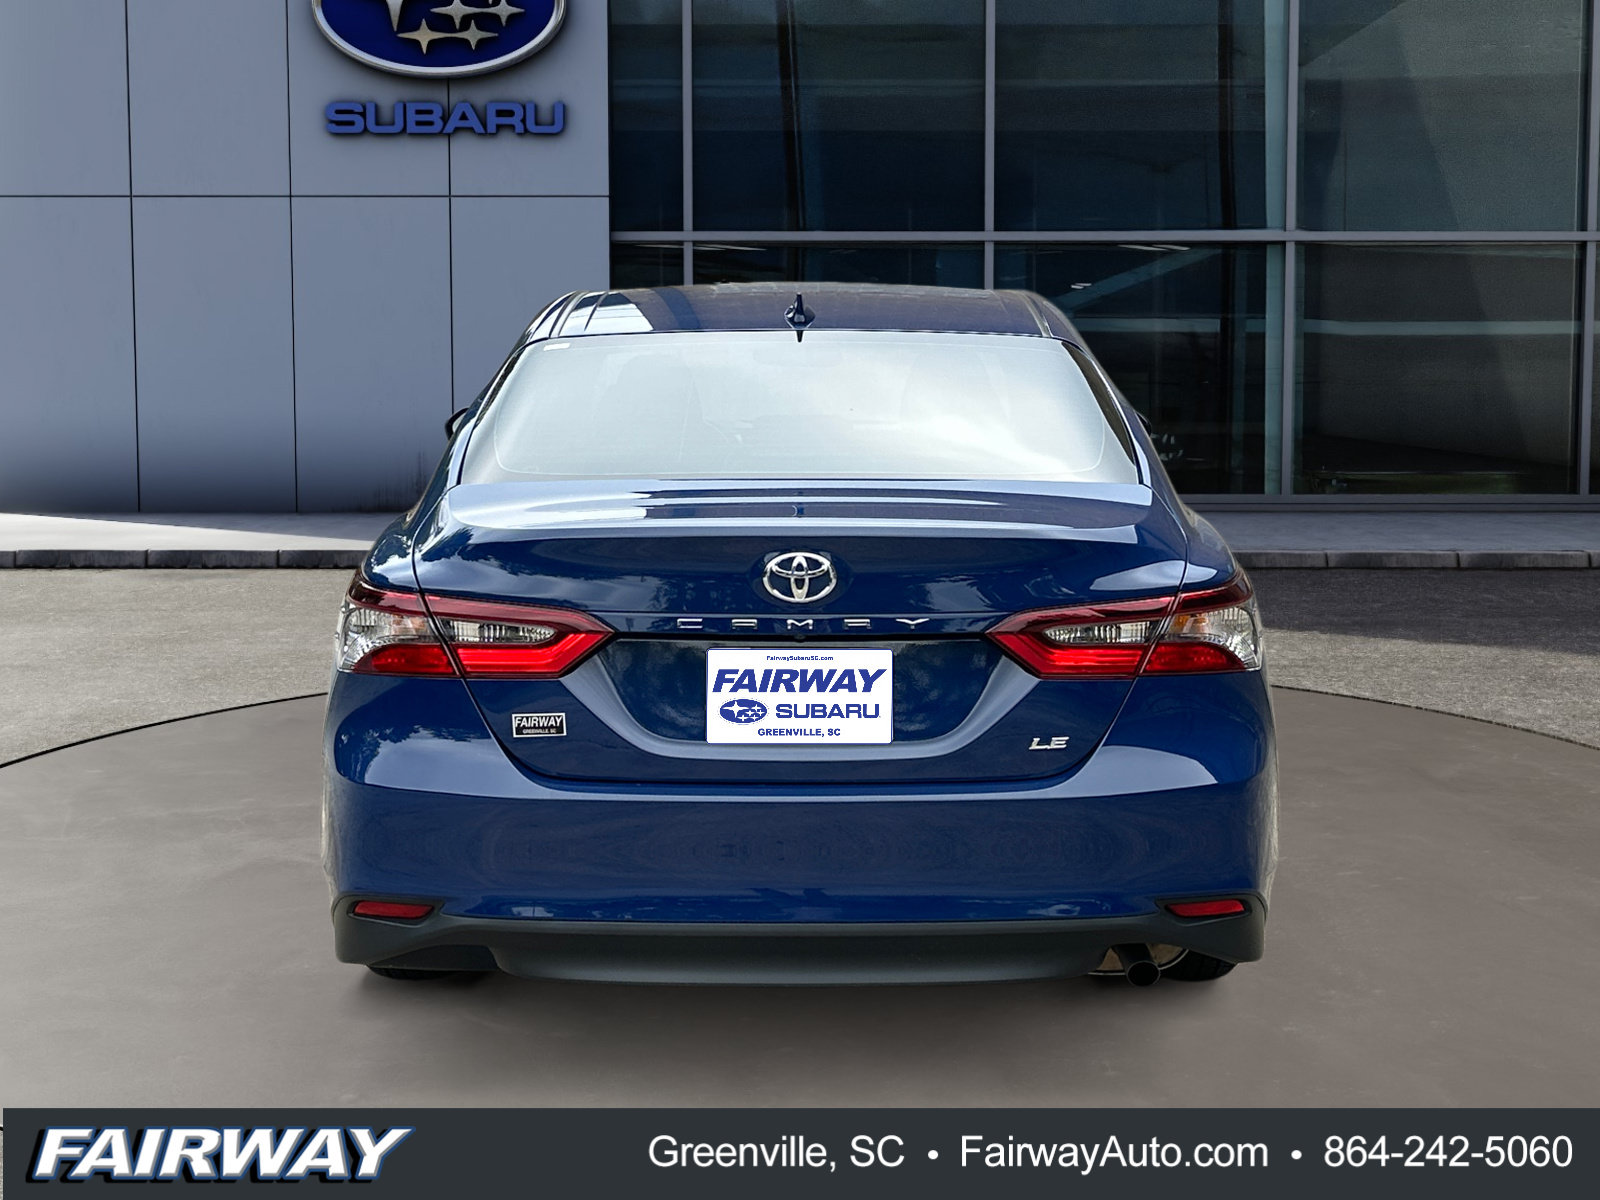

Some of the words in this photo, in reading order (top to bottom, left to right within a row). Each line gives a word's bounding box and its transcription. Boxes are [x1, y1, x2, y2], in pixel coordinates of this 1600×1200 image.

[325, 102, 565, 134] SUBARU
[677, 618, 930, 630] CAMRY
[712, 668, 888, 693] FAIRWAY
[775, 703, 880, 719] SUBARU
[515, 716, 562, 727] FAIRWAY
[757, 728, 825, 738] GREENVILLE,
[827, 728, 841, 737] SC
[1028, 736, 1070, 750] LE
